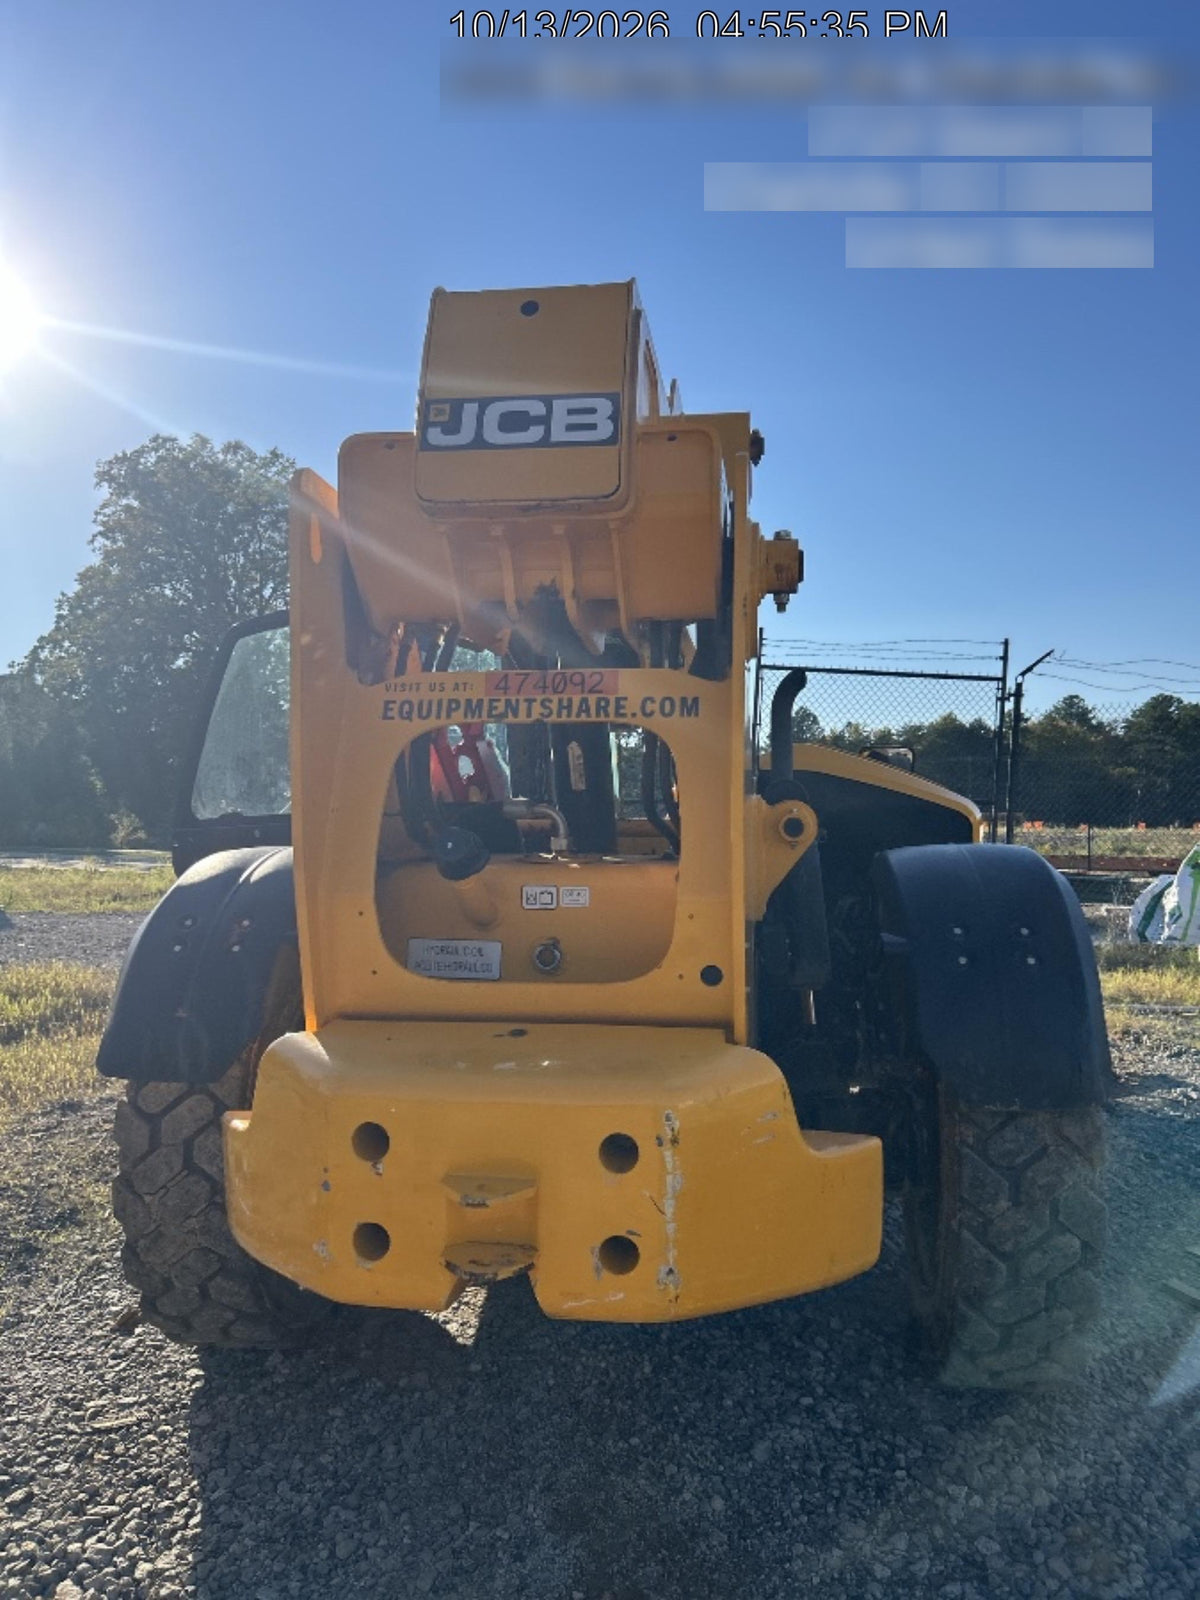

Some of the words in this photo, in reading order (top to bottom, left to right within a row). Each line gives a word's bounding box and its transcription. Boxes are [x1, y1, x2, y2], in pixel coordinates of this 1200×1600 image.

[427, 397, 614, 447] JCB
[385, 682, 421, 693] VISIT
[429, 682, 446, 692] US
[453, 682, 474, 692] AT:
[494, 671, 604, 695] 474092
[381, 695, 701, 722] EQUIPMENTSHARE.COM
